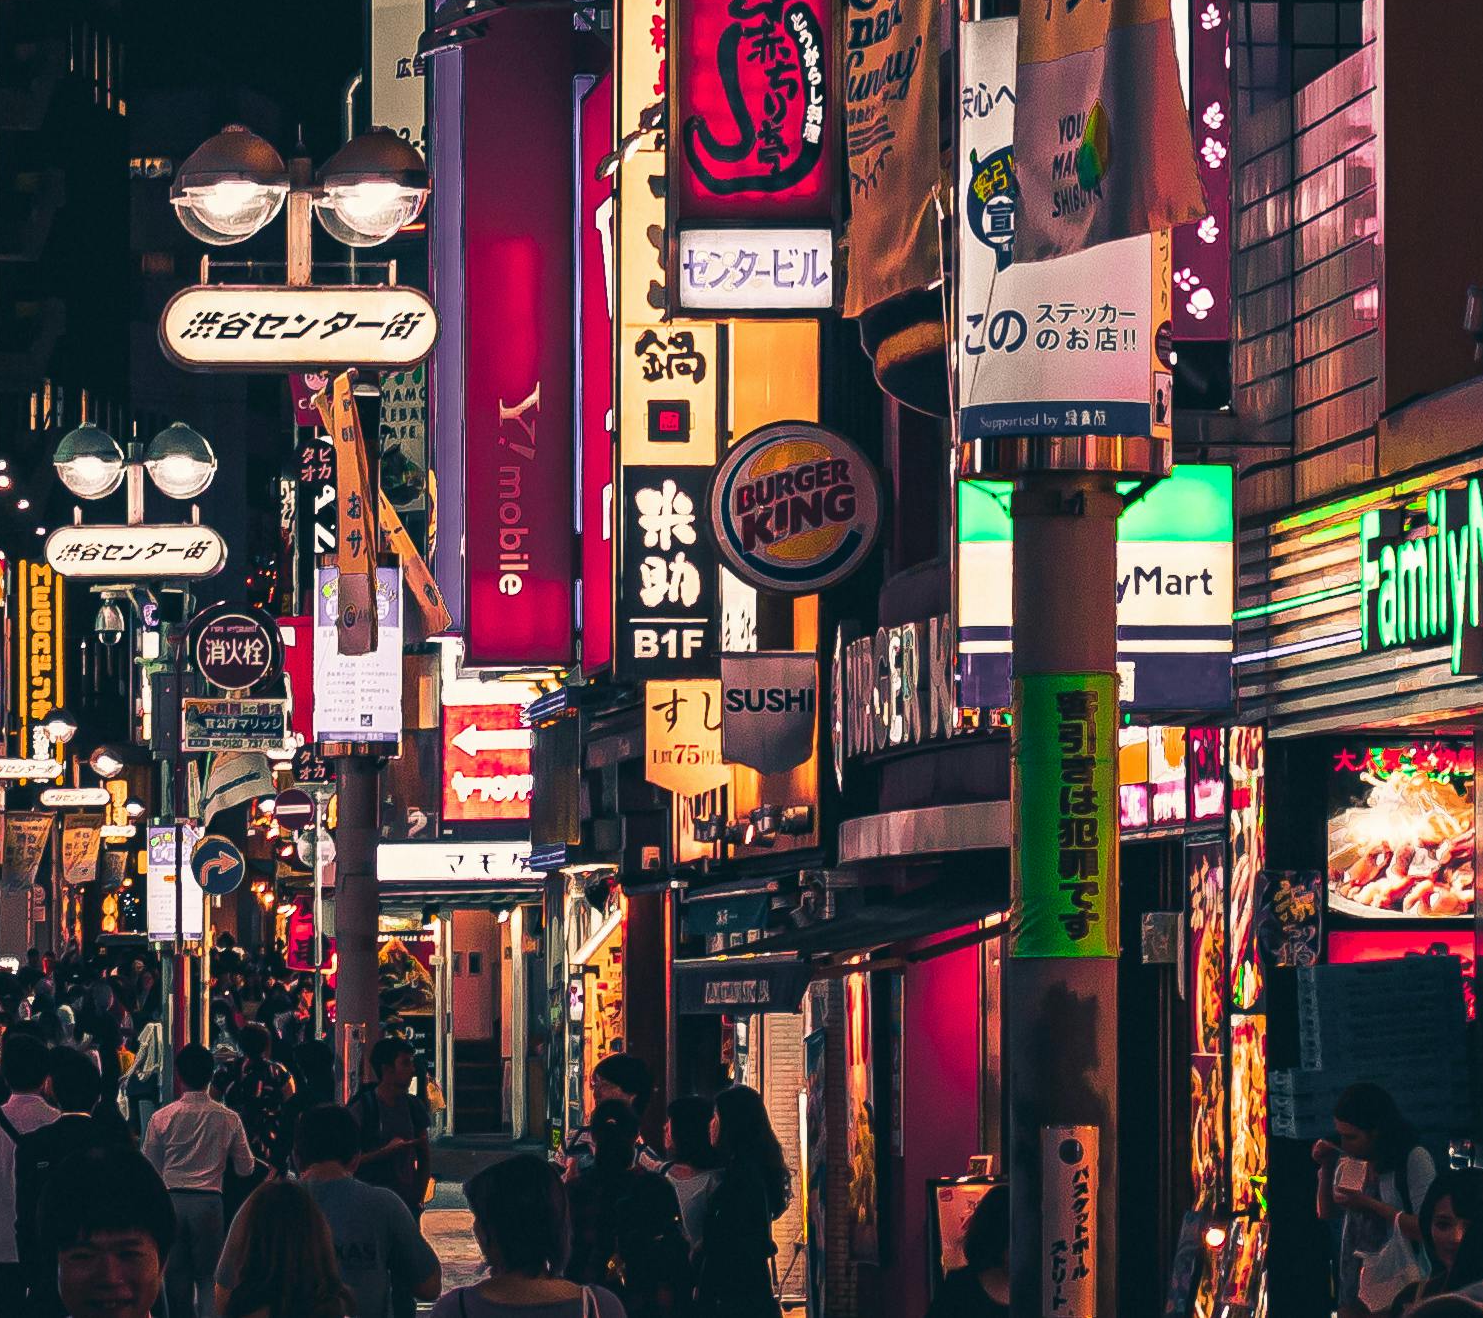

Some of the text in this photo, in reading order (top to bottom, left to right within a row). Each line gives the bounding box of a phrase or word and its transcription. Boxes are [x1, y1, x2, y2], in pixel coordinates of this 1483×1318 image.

[682, 245, 830, 290] センタービル
[180, 311, 424, 342] 渋谷センター街
[1035, 303, 1137, 325] ステッカー
[965, 309, 1028, 356] この
[1035, 327, 1138, 353] のお店!!
[634, 328, 707, 383] 鍋
[979, 413, 1041, 430] Supported
[1043, 413, 1060, 430] by
[300, 464, 333, 482] オカ
[734, 456, 853, 517] BURGER
[740, 482, 858, 555] KING
[55, 540, 214, 564] 渋谷センター街
[204, 636, 266, 668] 消火栓
[634, 628, 706, 660] B1F
[651, 688, 722, 734] すし
[724, 687, 815, 715] SUSHI
